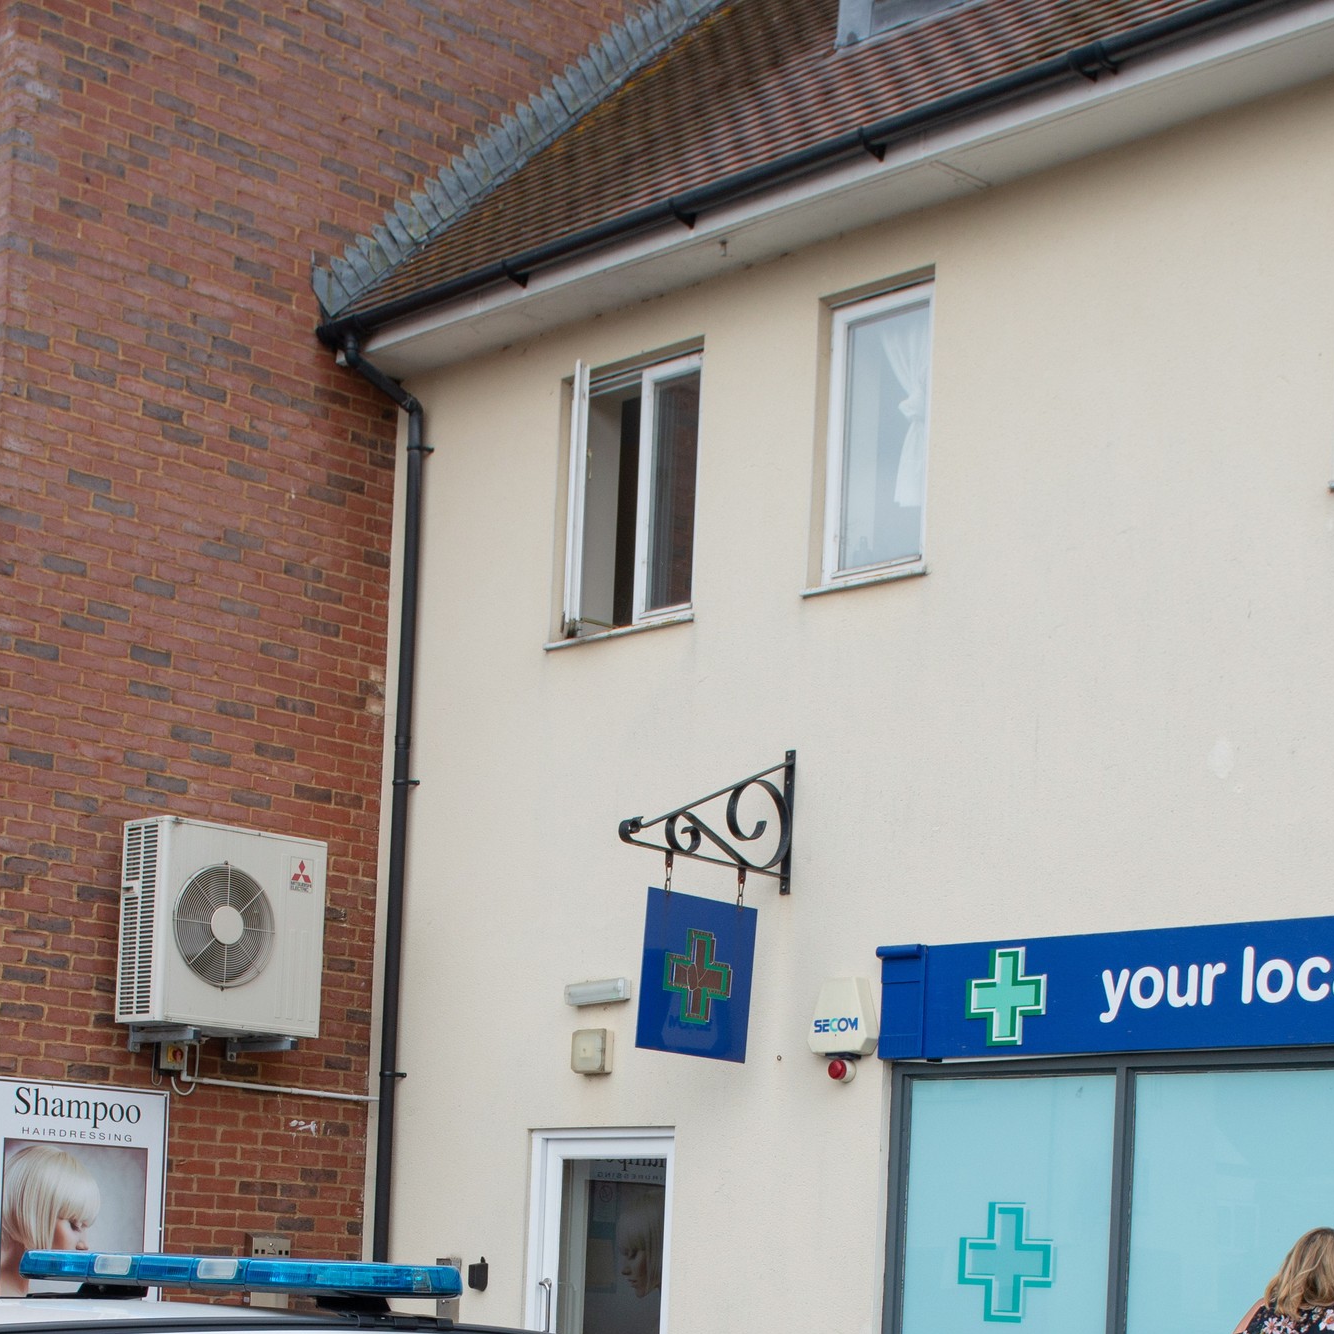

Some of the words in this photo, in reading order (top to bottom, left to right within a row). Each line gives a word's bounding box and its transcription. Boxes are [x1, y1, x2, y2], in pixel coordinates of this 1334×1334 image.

[1099, 961, 1228, 1024] your
[814, 1017, 858, 1033] SECOM
[14, 1086, 141, 1128] Shampoo
[21, 1126, 134, 1144] HAIRDRESSING
